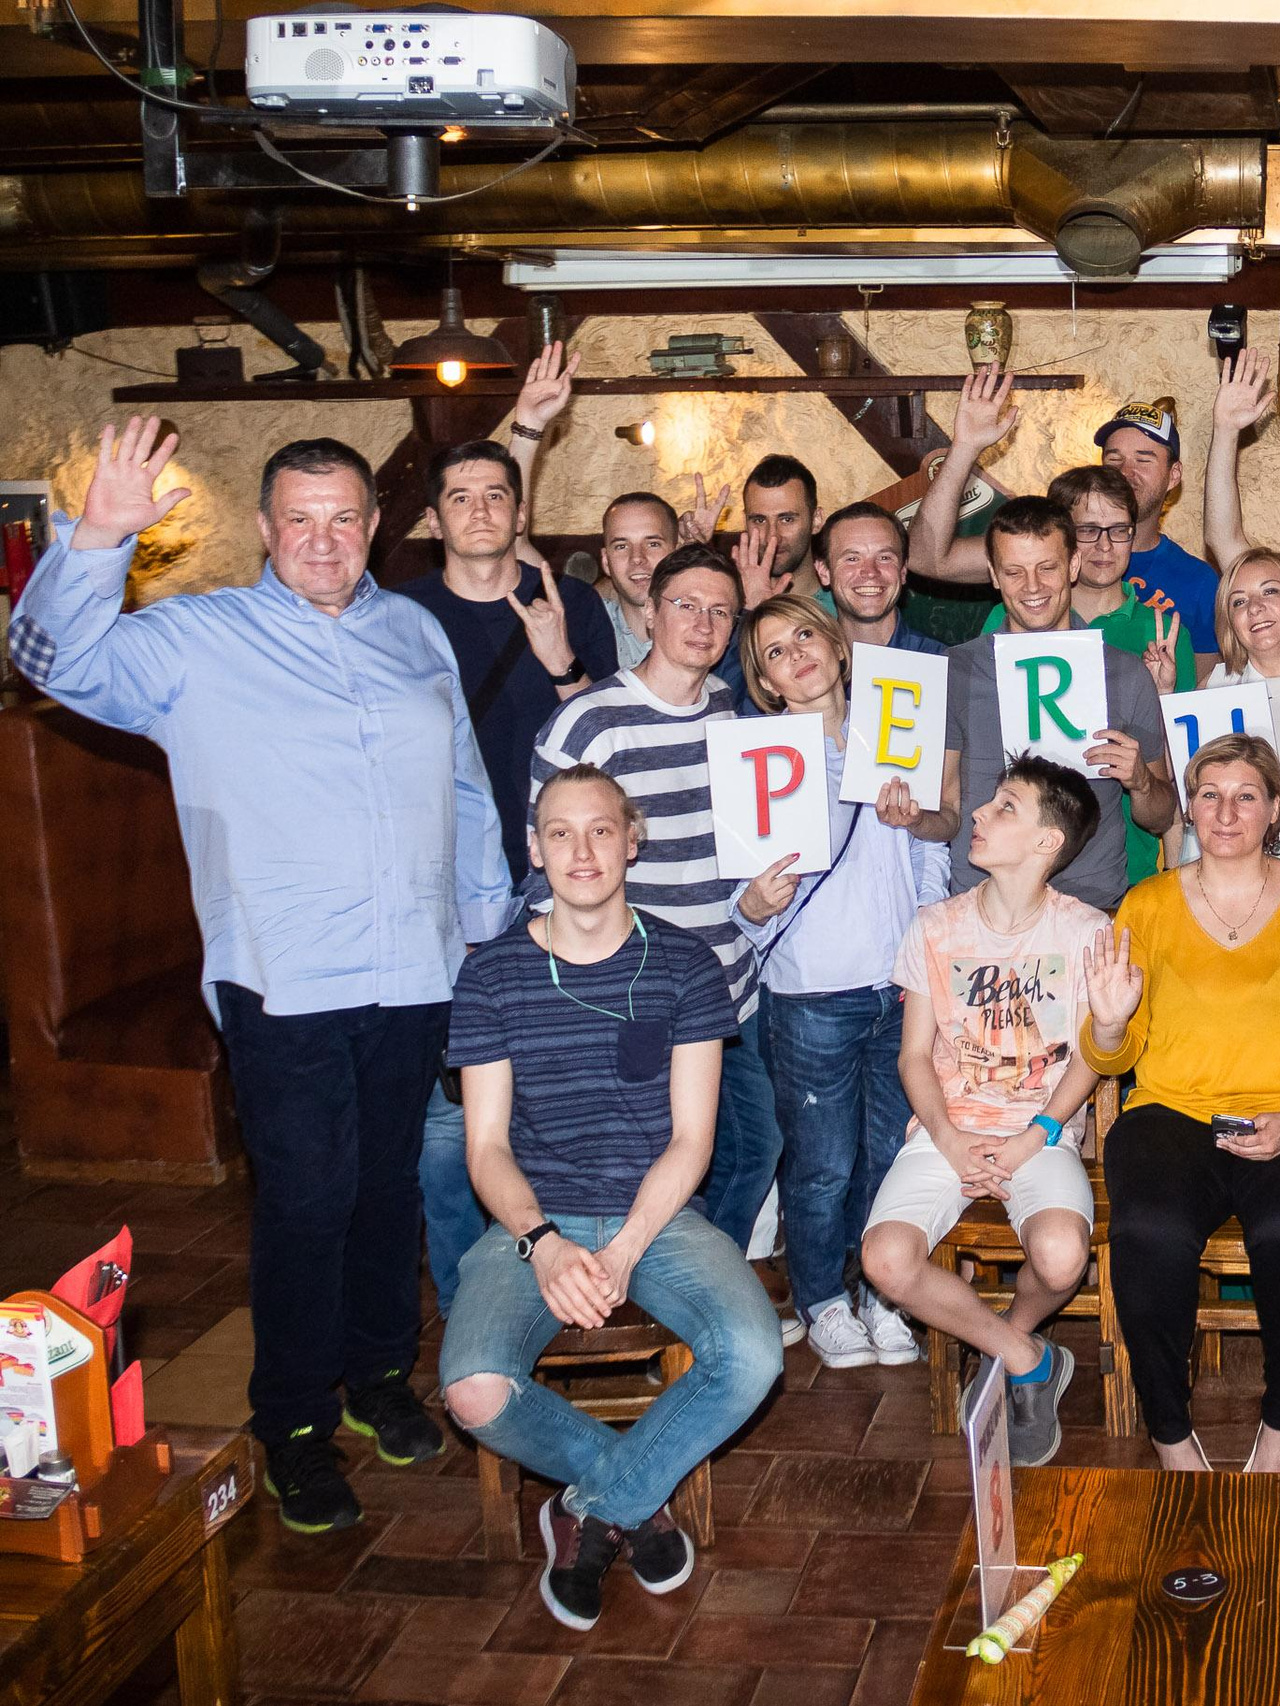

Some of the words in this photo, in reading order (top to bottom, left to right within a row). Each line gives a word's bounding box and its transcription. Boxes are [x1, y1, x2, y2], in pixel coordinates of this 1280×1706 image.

[1015, 655, 1087, 741] R
[873, 678, 921, 769] E
[742, 746, 805, 836] P
[967, 959, 1044, 1007] Beach
[981, 1005, 1036, 1031] PLEASE
[960, 1040, 970, 1051] TO
[208, 1474, 237, 1521] 234
